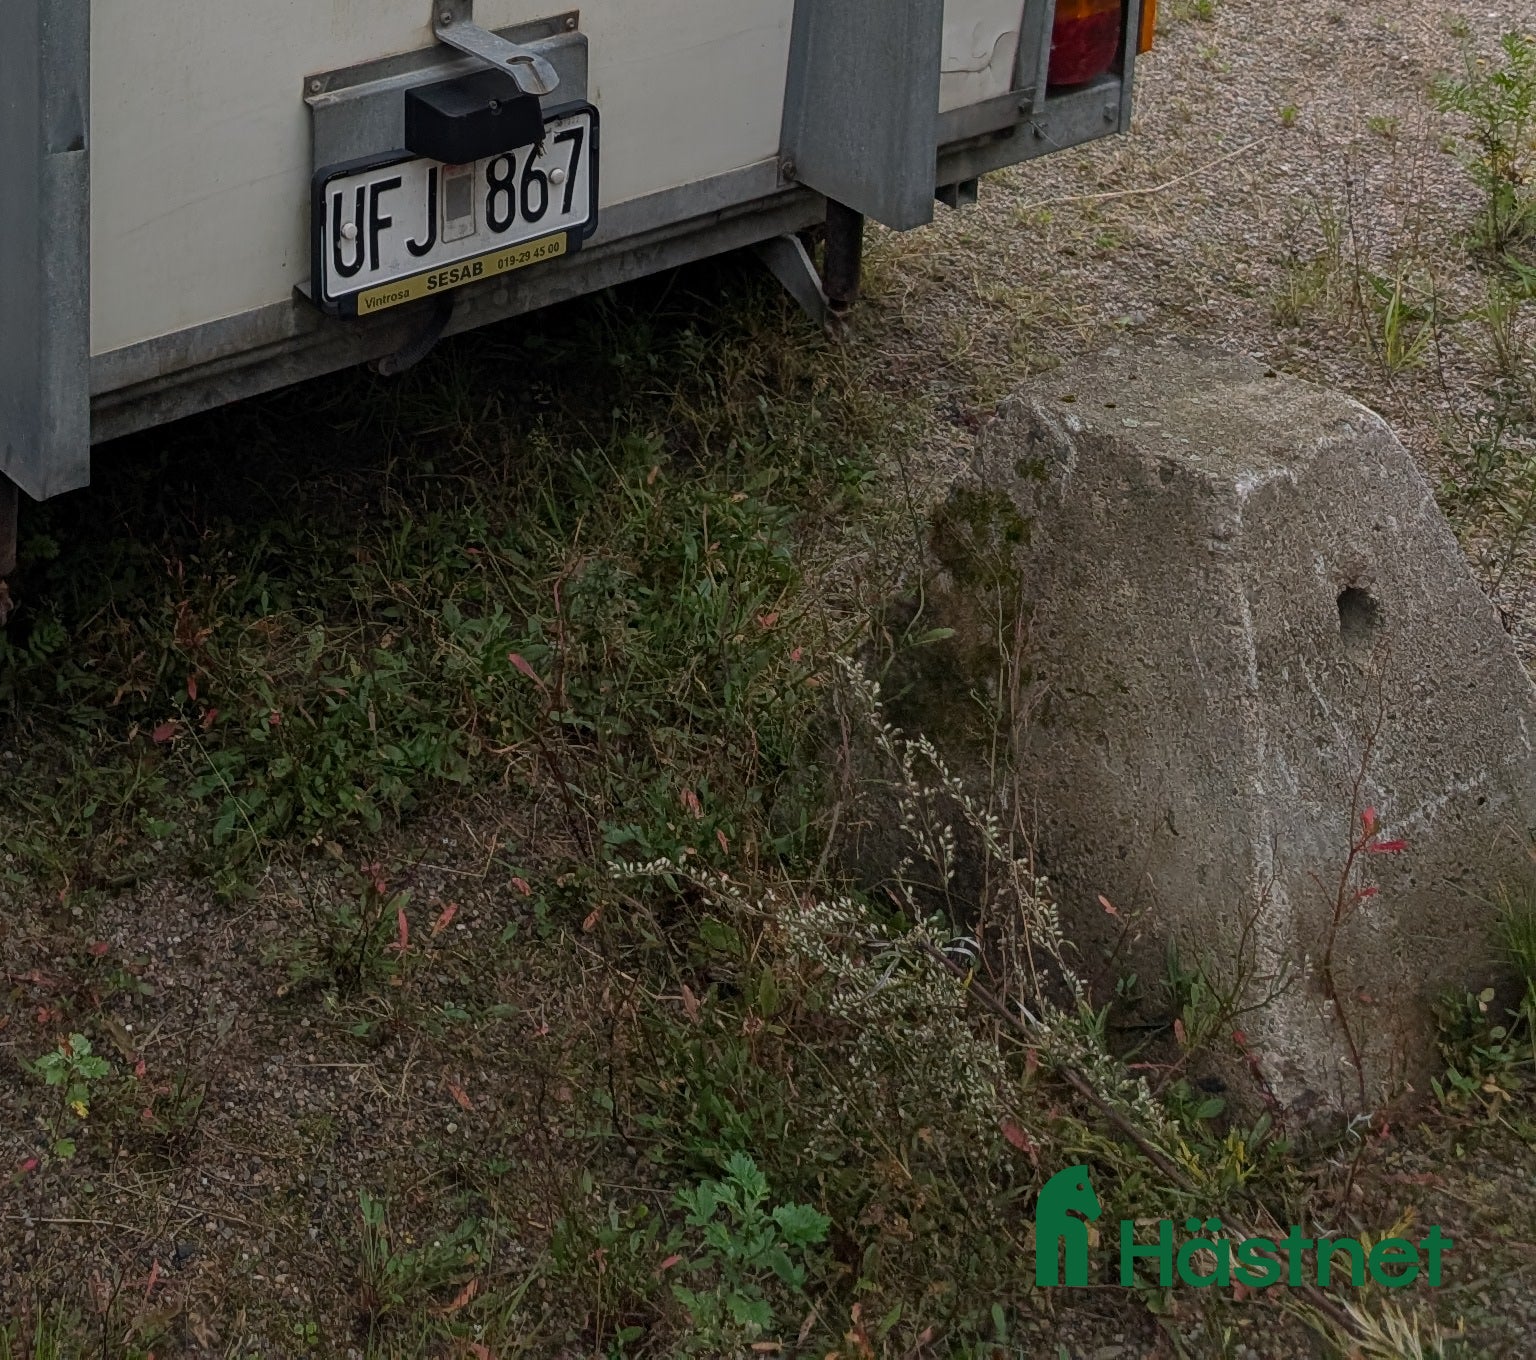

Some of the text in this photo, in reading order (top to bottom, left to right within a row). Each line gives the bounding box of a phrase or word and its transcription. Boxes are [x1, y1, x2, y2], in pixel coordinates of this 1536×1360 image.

[332, 126, 585, 279] UFJ 867
[364, 241, 560, 310] Vintrosa SESAB 019-29 45 00
